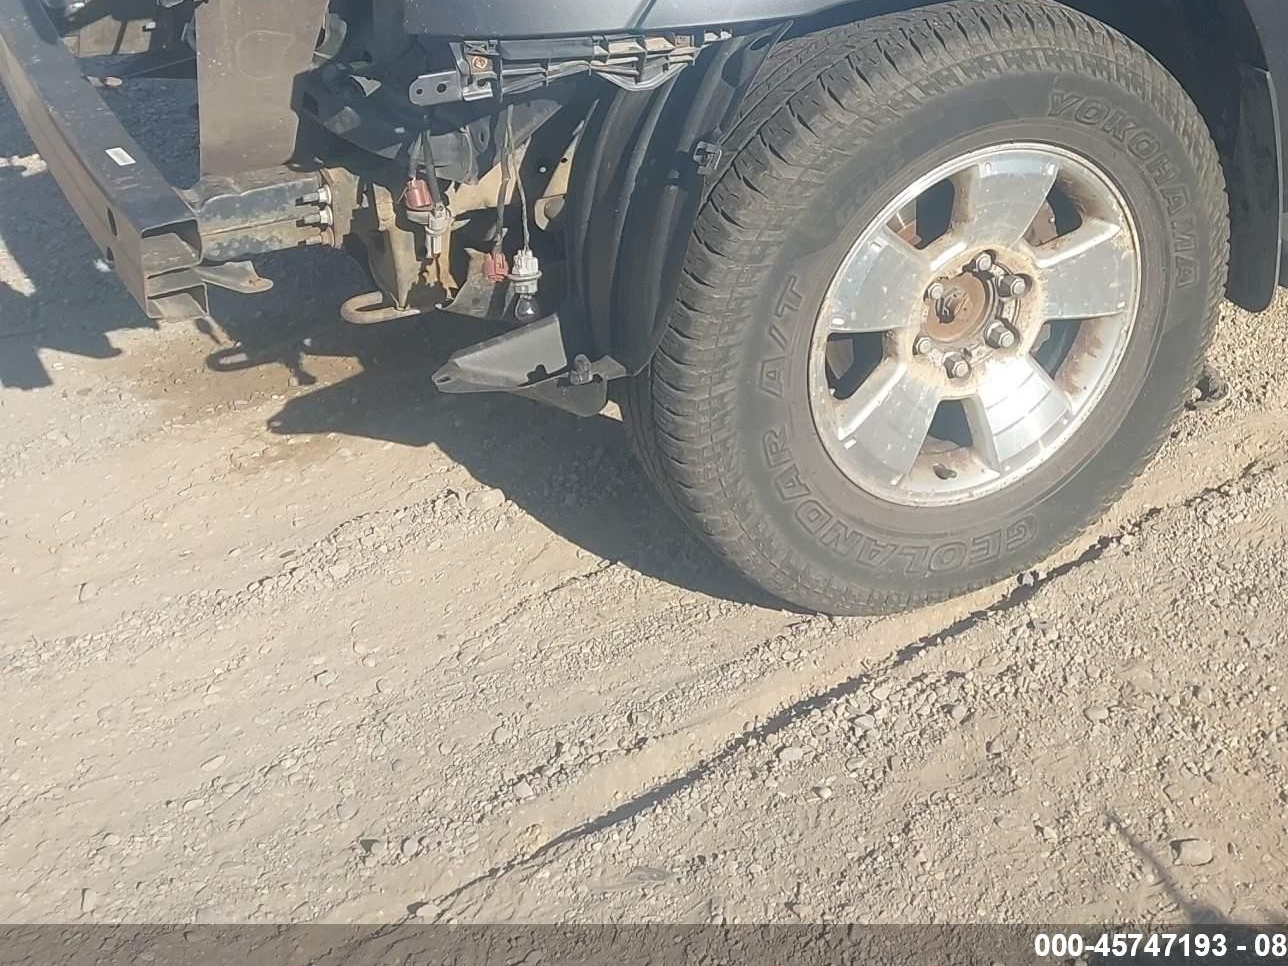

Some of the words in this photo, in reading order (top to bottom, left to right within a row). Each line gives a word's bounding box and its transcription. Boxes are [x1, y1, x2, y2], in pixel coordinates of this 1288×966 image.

[1048, 89, 1200, 289] YOKOHAMA
[758, 275, 804, 398] A/T
[763, 423, 1040, 575] GEOLANDAR
